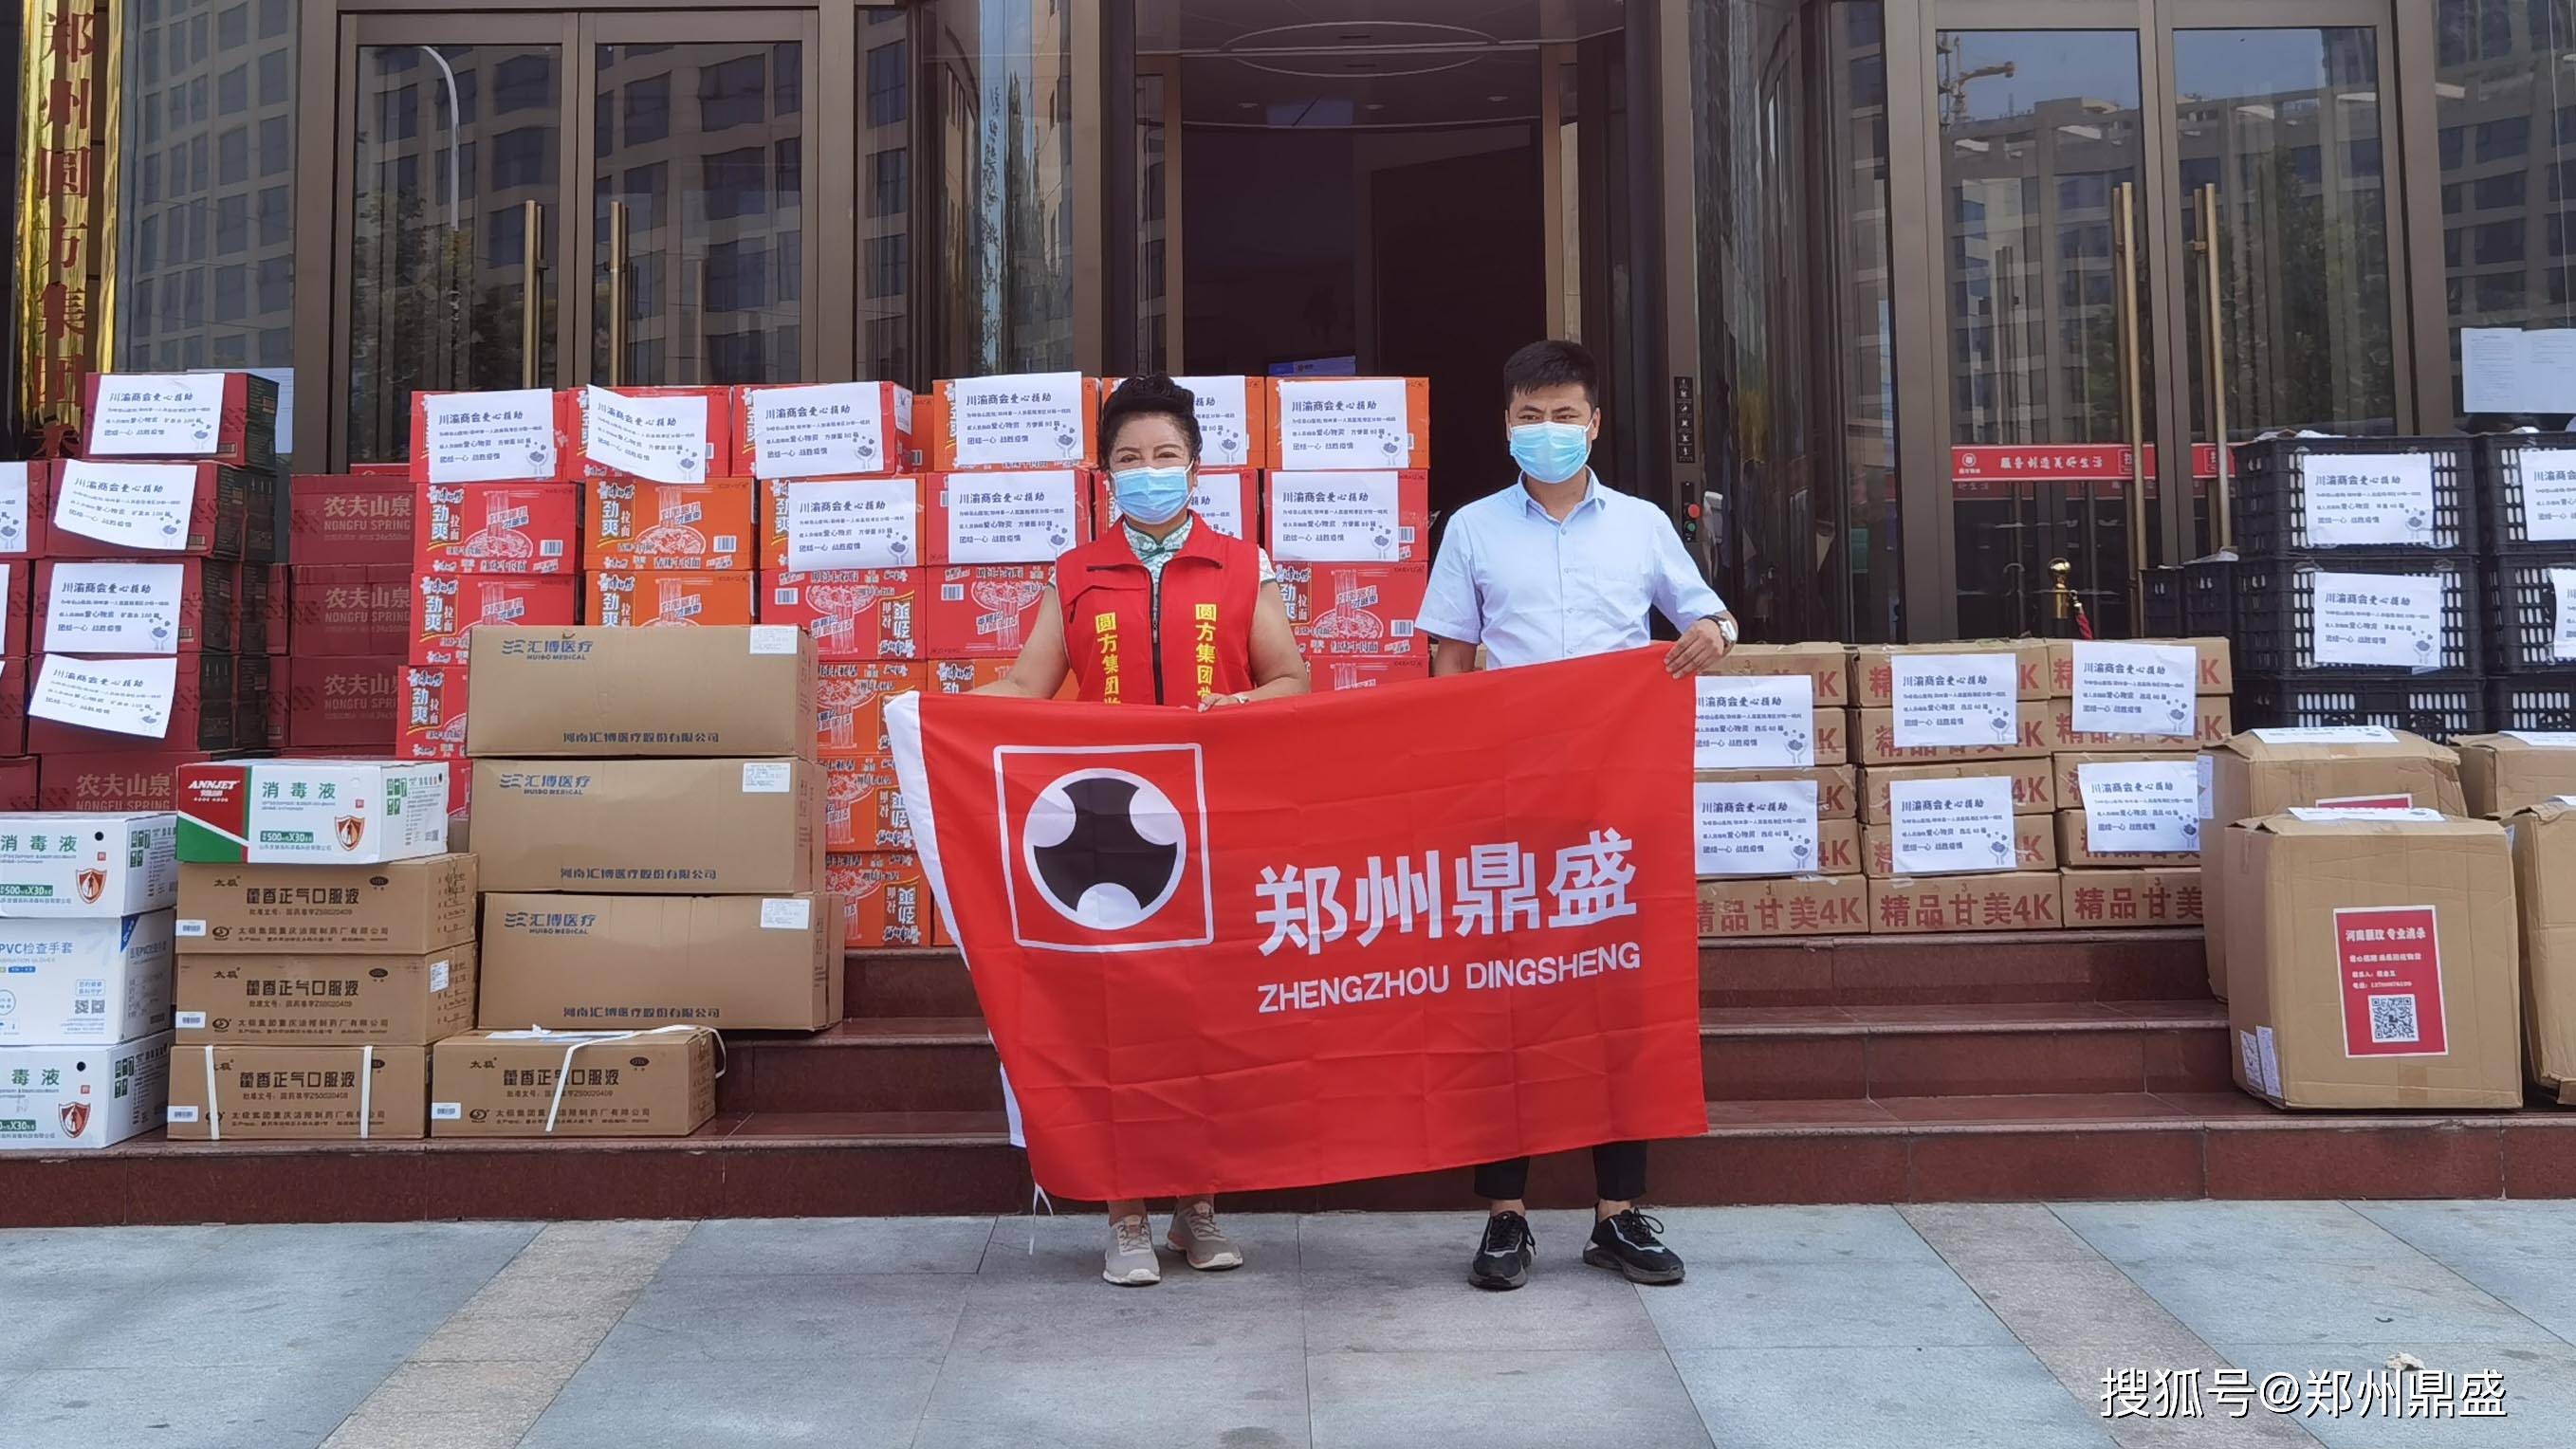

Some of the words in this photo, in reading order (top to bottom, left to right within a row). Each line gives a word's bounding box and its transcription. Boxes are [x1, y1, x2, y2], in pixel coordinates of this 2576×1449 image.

[324, 495, 412, 517] 农夫山泉
[324, 520, 367, 530] NONGFU
[371, 520, 411, 530] SPRING
[325, 612, 368, 623] NONGFU
[527, 640, 593, 652] 汇博医疗
[325, 698, 367, 709] NONGFU
[563, 732, 719, 743] 河南汇博医疗股份有限公司
[76, 774, 171, 798] 农夫山泉
[189, 780, 240, 790] ANNJET
[524, 774, 592, 788] 汇博医疗
[261, 781, 337, 799] 消毒液
[76, 801, 123, 812] NONGFU
[128, 801, 170, 812] SPRING
[1, 835, 78, 853] 消毒液
[561, 868, 717, 880] 河南汇博医疗股份有限公司
[247, 887, 359, 905] 藿香正气口服液
[1255, 827, 1637, 956] 郑州鼎盛
[1881, 891, 2054, 927] 精品甘美4K
[529, 913, 597, 927] 汇博医疗
[1258, 965, 1449, 1013] ZHENGZHOU
[1465, 941, 1640, 990] DINGSHENG
[246, 980, 359, 997] 藿香正气口服液
[563, 1007, 720, 1018] 河南汇博医疗股份有限公司
[239, 1072, 356, 1089] 藿香正气口服液
